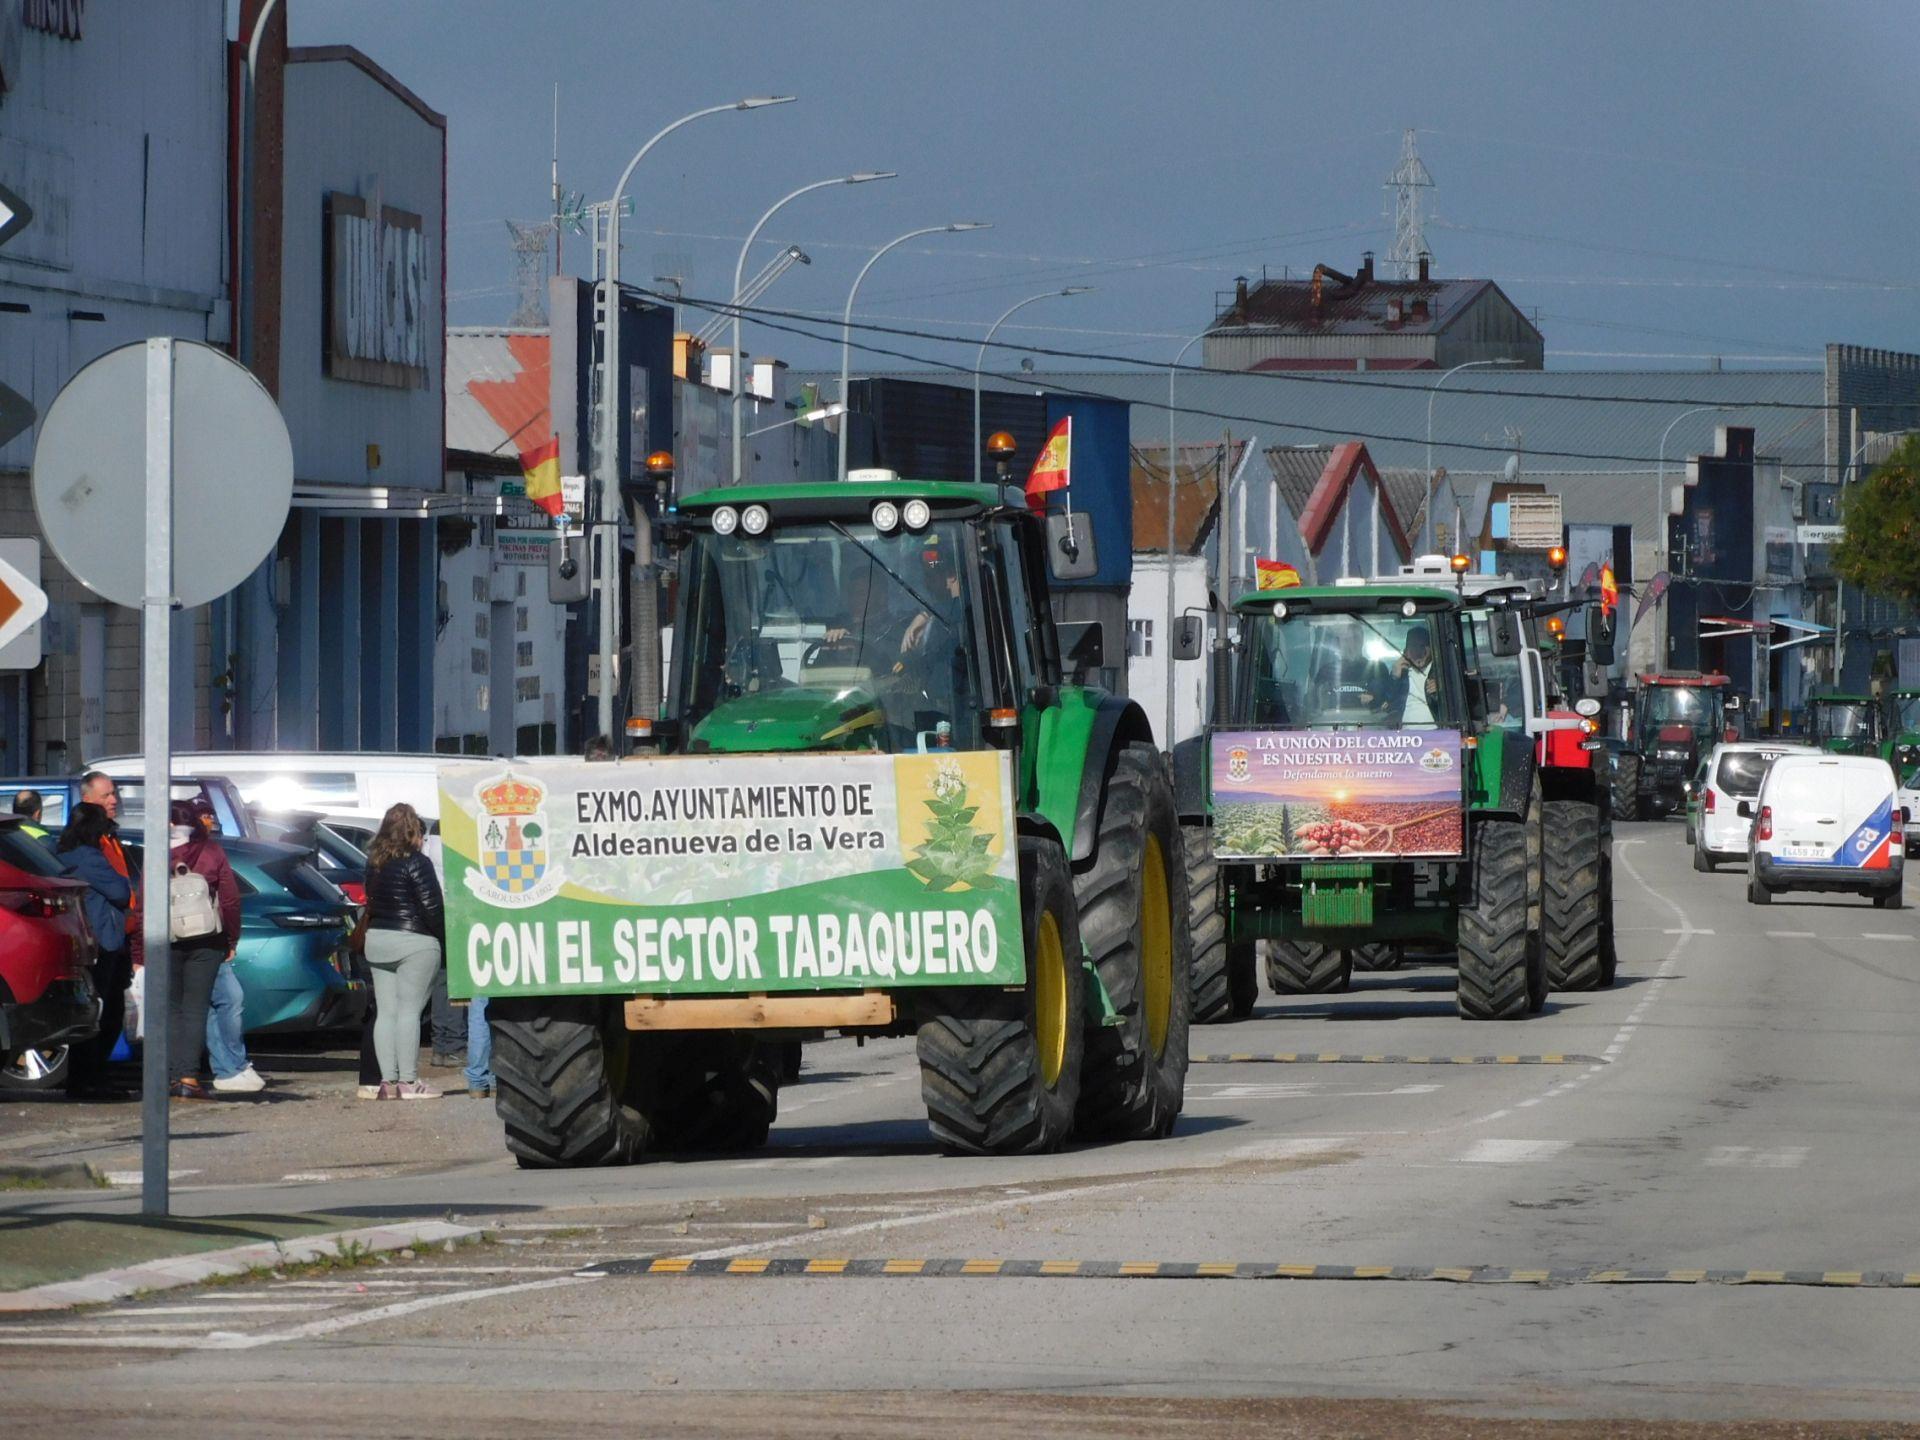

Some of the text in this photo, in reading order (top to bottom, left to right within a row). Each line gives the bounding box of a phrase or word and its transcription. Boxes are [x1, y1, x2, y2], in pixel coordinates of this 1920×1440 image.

[1256, 737, 1275, 750] LA
[1279, 734, 1331, 749] UNIÓN
[1335, 736, 1366, 749] DEL
[1367, 735, 1423, 748] CAMPO
[1263, 753, 1280, 766] ES
[1283, 752, 1353, 765] NUESTRA
[1357, 751, 1415, 764] FUERZA
[1283, 769, 1393, 781] Defendamos lo nuestro
[842, 784, 874, 816] DE
[571, 826, 885, 857] Aldeanueva de la Vera
[467, 908, 998, 987] CON EL SECTOR TABAQUERO
